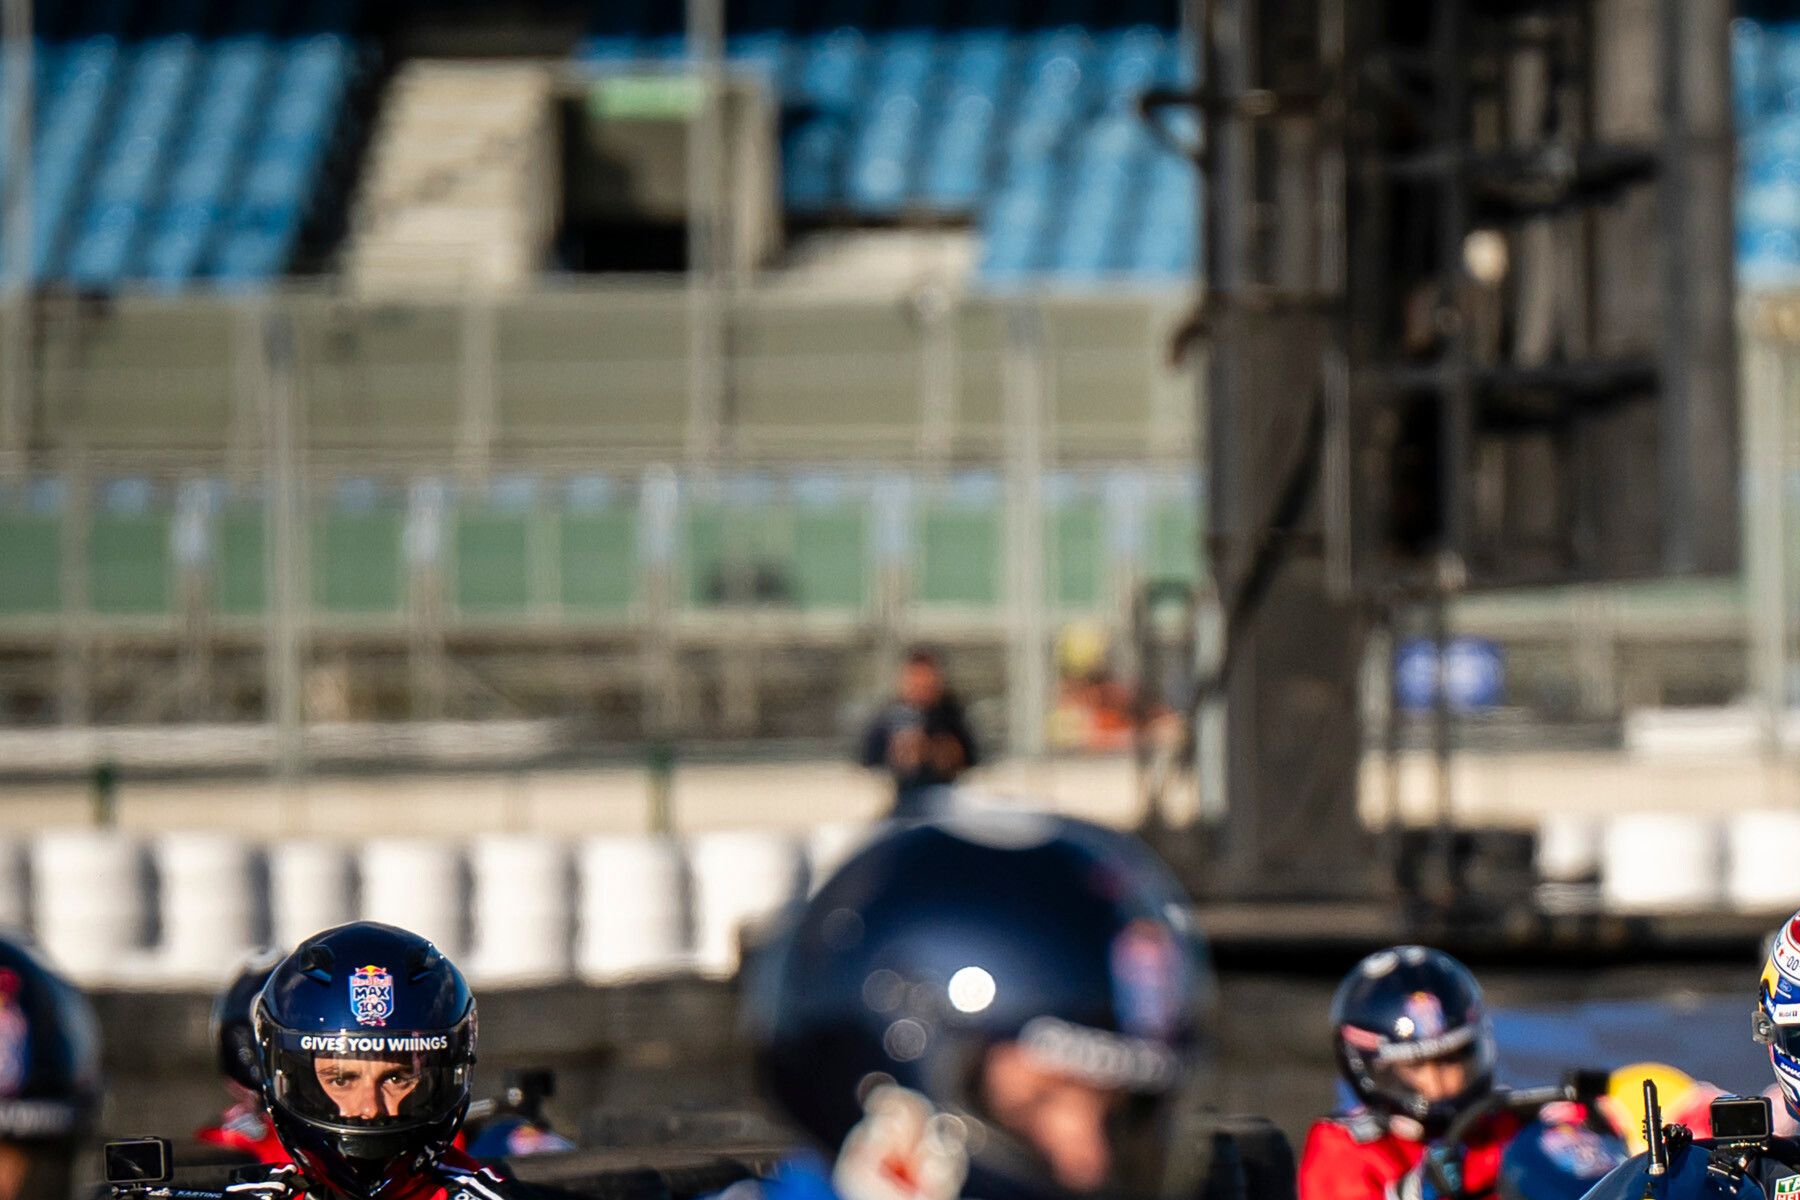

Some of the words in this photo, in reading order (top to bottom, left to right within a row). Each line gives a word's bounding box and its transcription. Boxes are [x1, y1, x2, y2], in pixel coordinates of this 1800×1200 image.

[354, 986, 389, 1000] MAX
[358, 1001, 387, 1014] 100
[300, 1035, 345, 1051] GIVES
[350, 1037, 385, 1051] YOU
[388, 1035, 448, 1051] WIIINGS
[176, 1189, 223, 1200] KARTING
